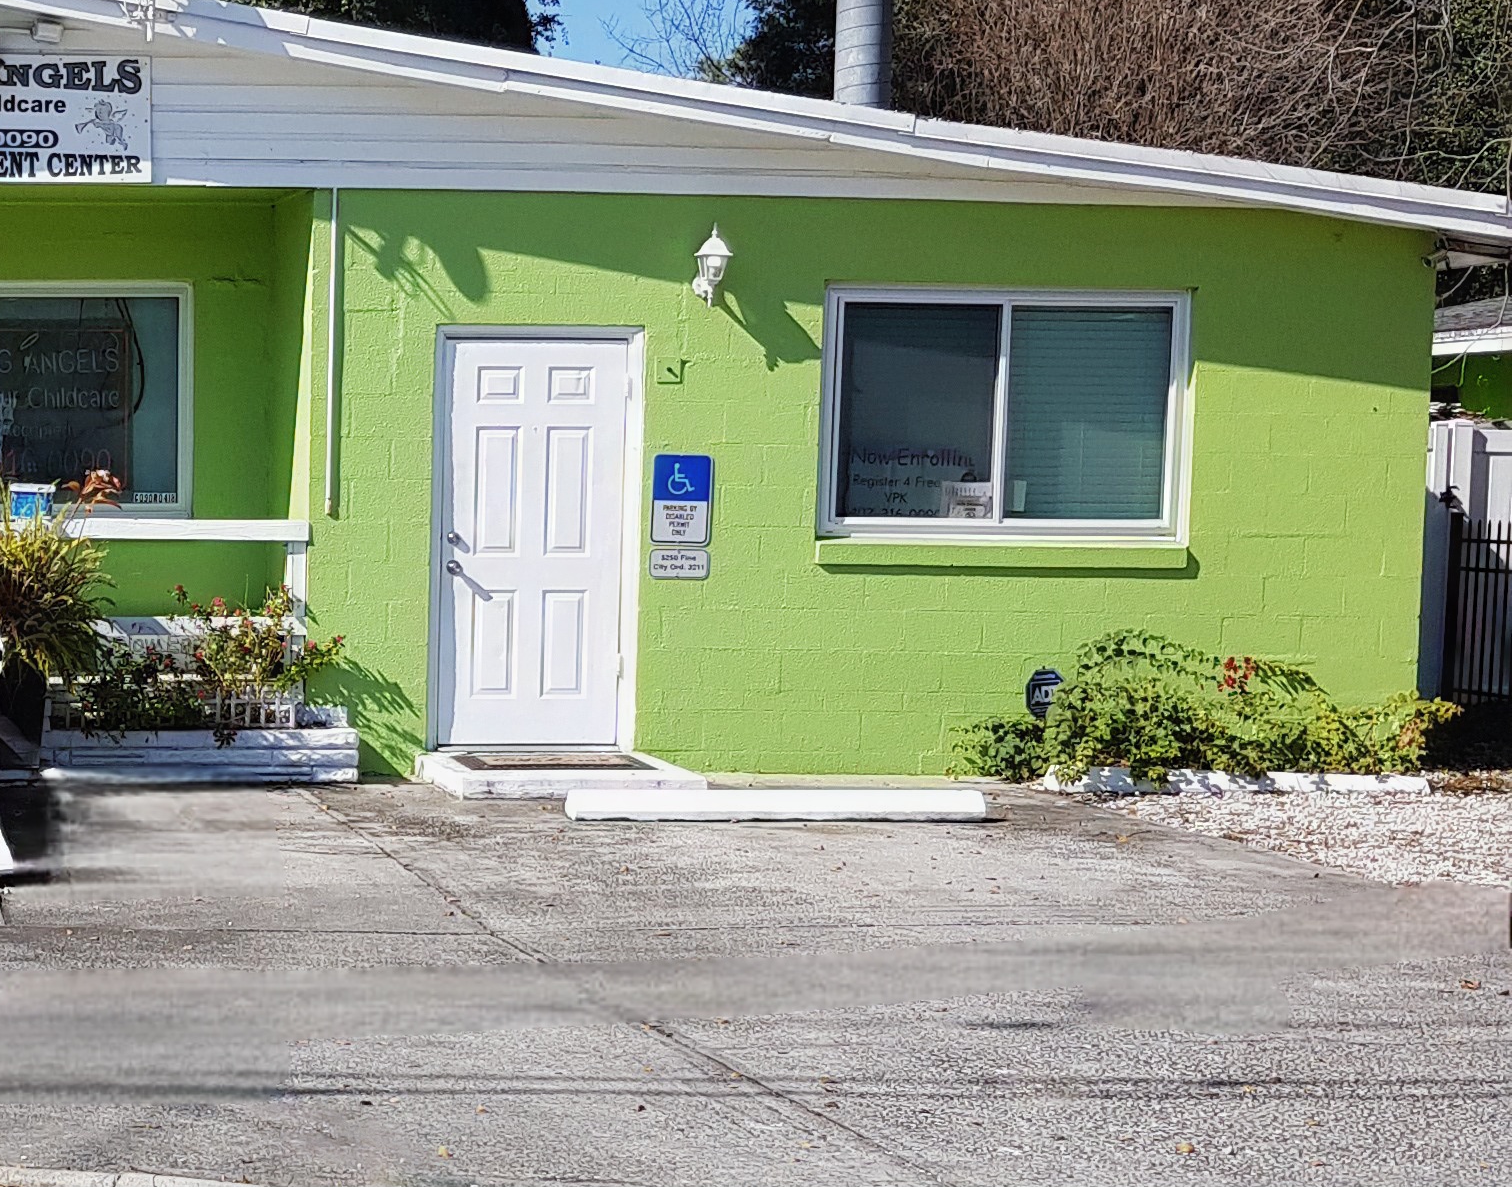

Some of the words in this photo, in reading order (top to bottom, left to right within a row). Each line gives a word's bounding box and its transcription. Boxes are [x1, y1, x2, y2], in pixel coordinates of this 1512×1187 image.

[47, 153, 142, 177] CENTER
[24, 348, 119, 374] ANGELS
[28, 386, 120, 409] Childcare
[851, 448, 889, 465] Now
[853, 474, 899, 488] Register
[884, 492, 908, 503] VPK
[1031, 685, 1059, 704] AD
